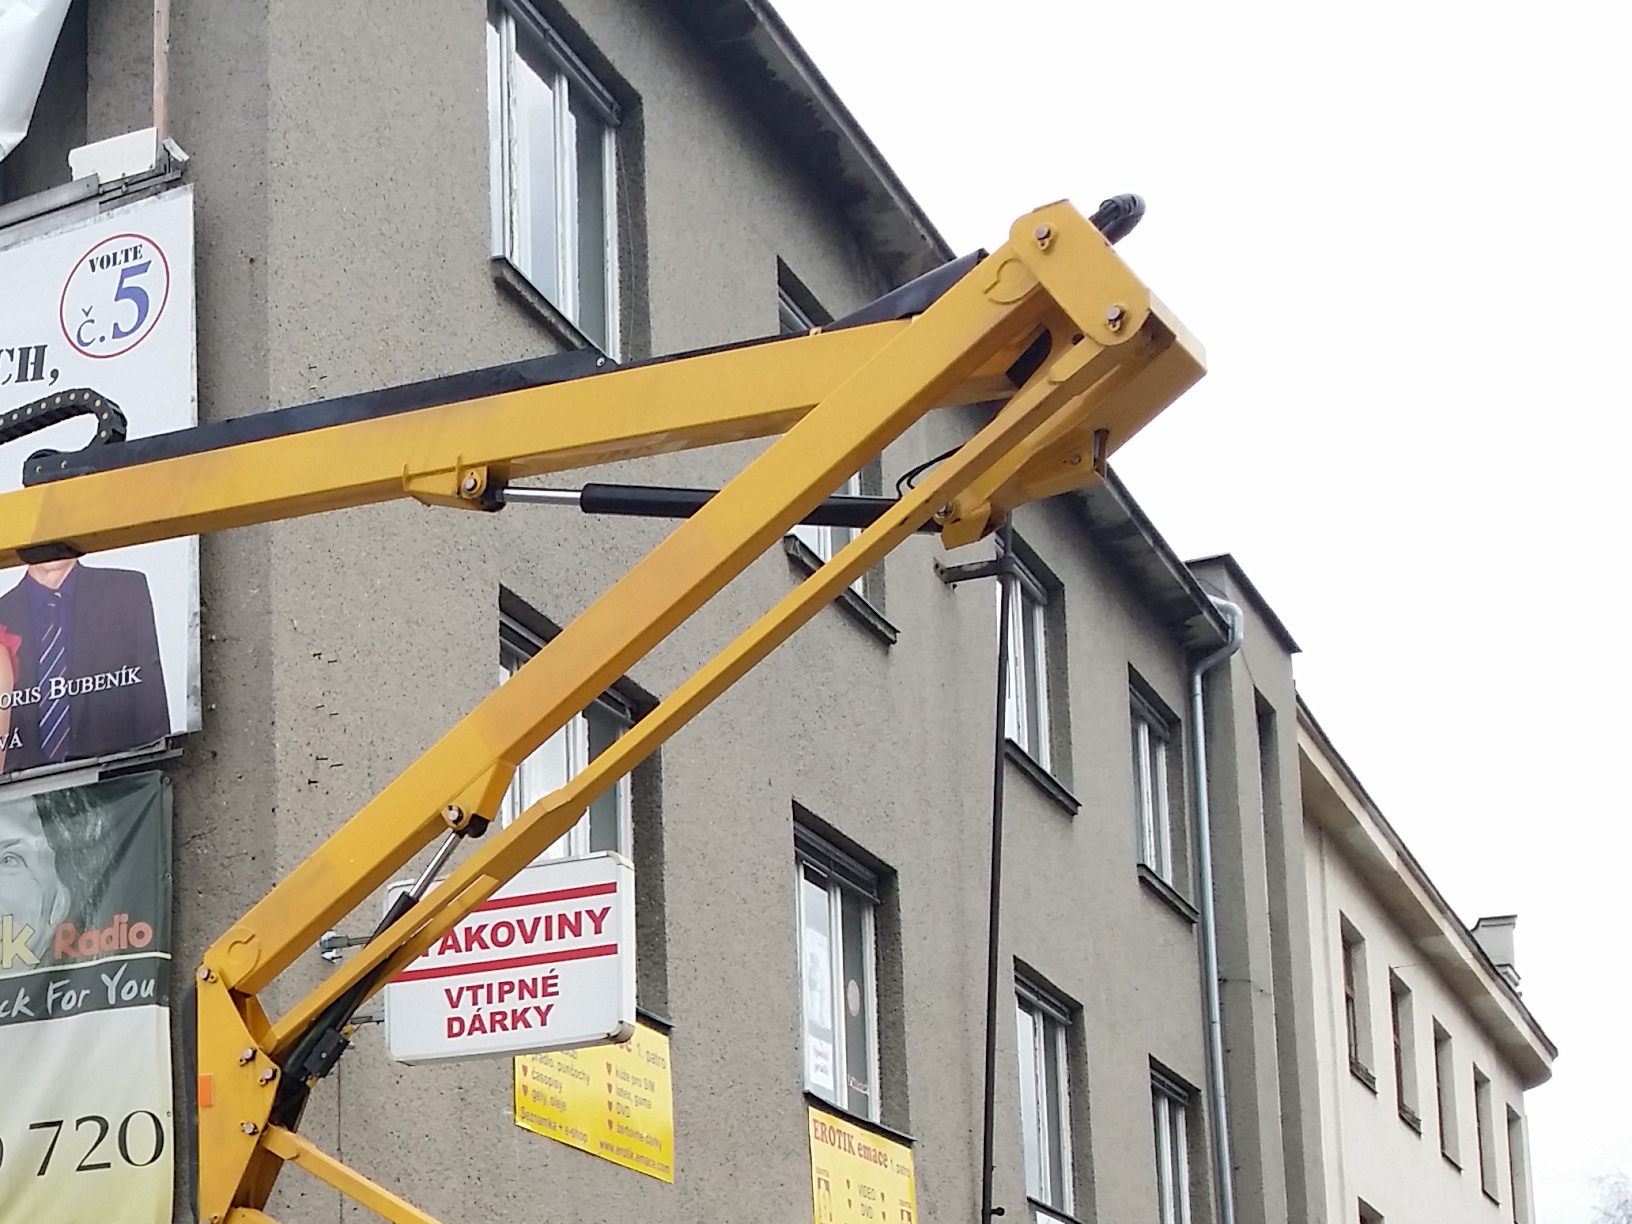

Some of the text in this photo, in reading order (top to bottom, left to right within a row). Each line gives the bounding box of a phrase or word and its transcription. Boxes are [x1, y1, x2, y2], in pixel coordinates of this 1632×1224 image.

[88, 243, 144, 273] VOLTE
[48, 664, 143, 701] BUBENÍK
[53, 911, 153, 961] Radio
[46, 978, 91, 1015] For
[100, 962, 156, 1001] You
[443, 968, 560, 1010] VTIPNÉ
[446, 1004, 555, 1039] DÁRKY
[27, 1109, 165, 1178] 720
[812, 1118, 856, 1156] EROTIK
[857, 1141, 889, 1169] emace
[857, 1182, 876, 1201] VIDEO
[860, 1203, 873, 1219] DVD
